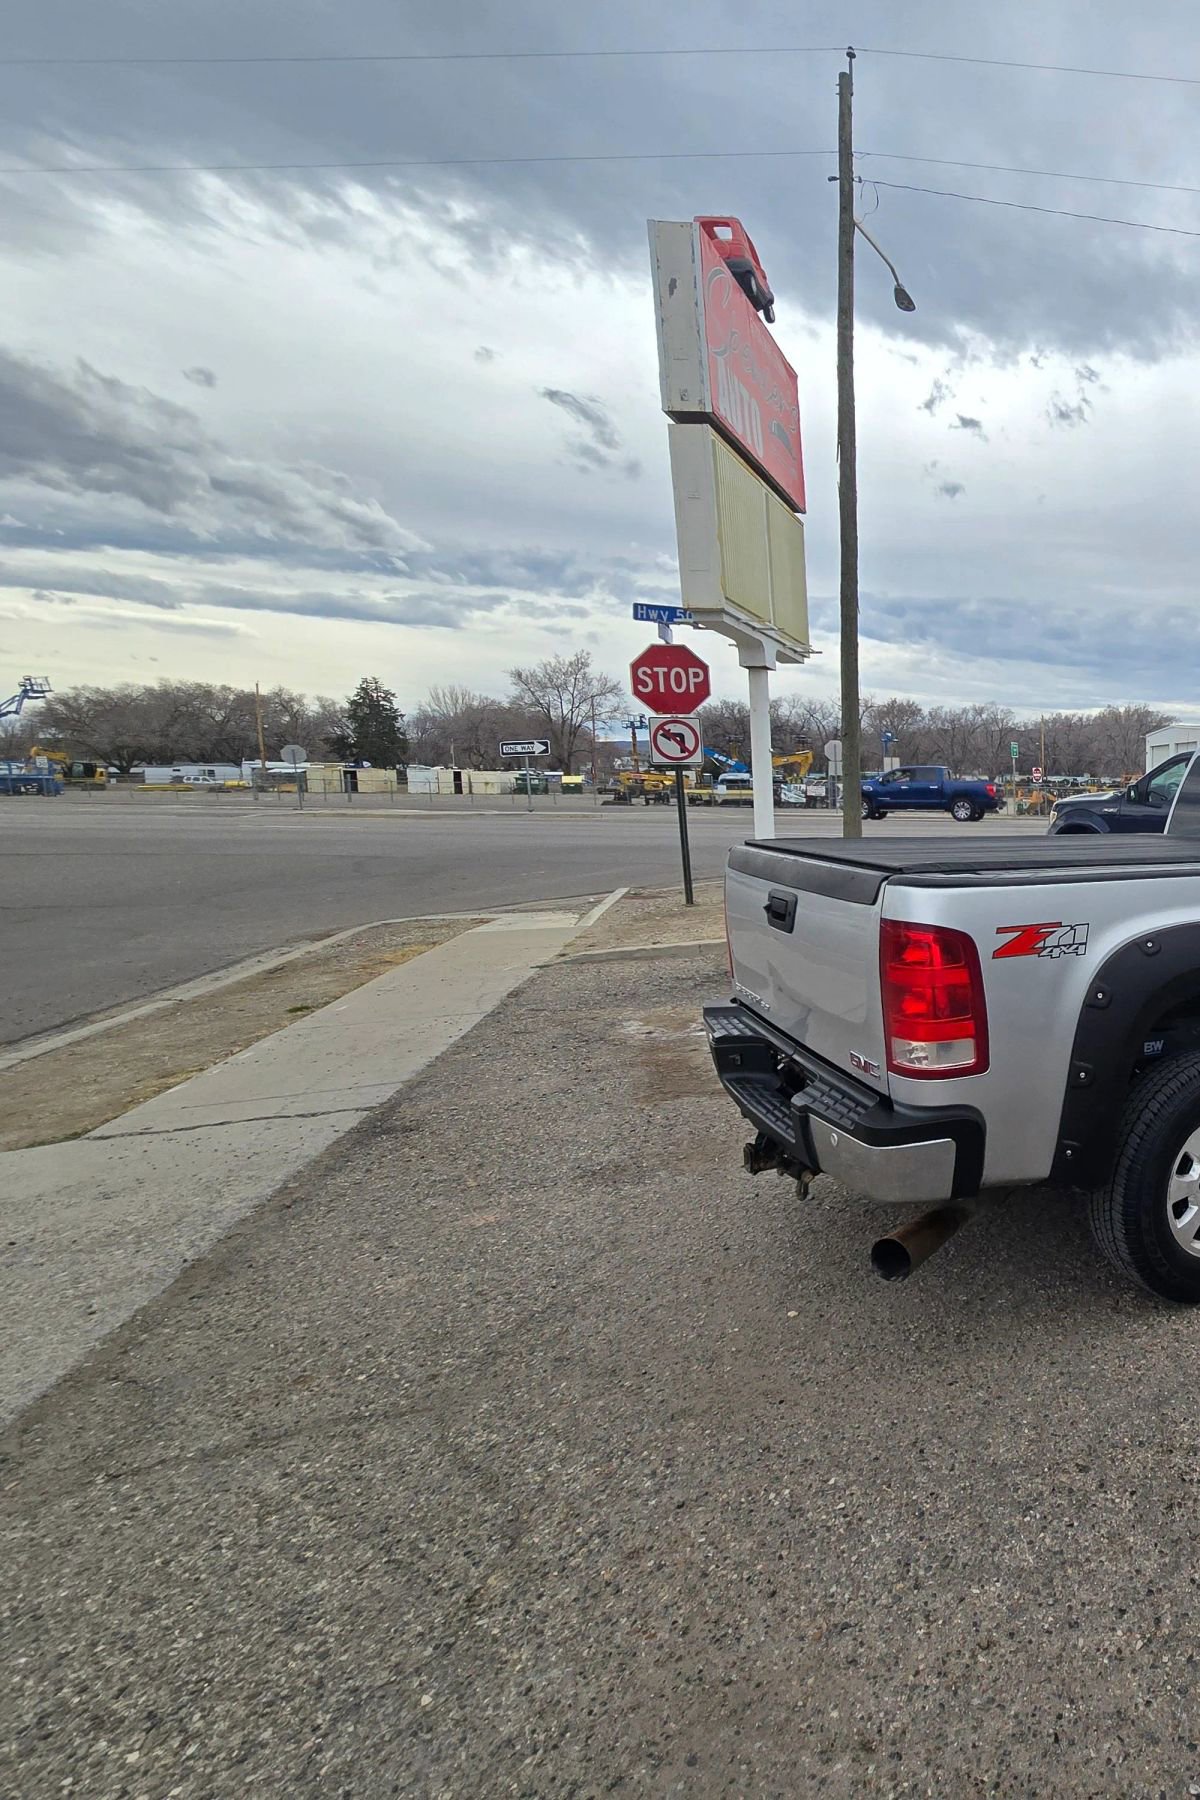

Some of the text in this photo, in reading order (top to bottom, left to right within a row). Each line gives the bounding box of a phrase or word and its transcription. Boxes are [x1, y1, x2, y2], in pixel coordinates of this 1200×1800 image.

[717, 357, 766, 460] AUTO
[637, 604, 669, 622] Hwy
[637, 666, 704, 694] STOP
[992, 921, 1090, 959] Z71
[850, 1050, 881, 1080] GMC
